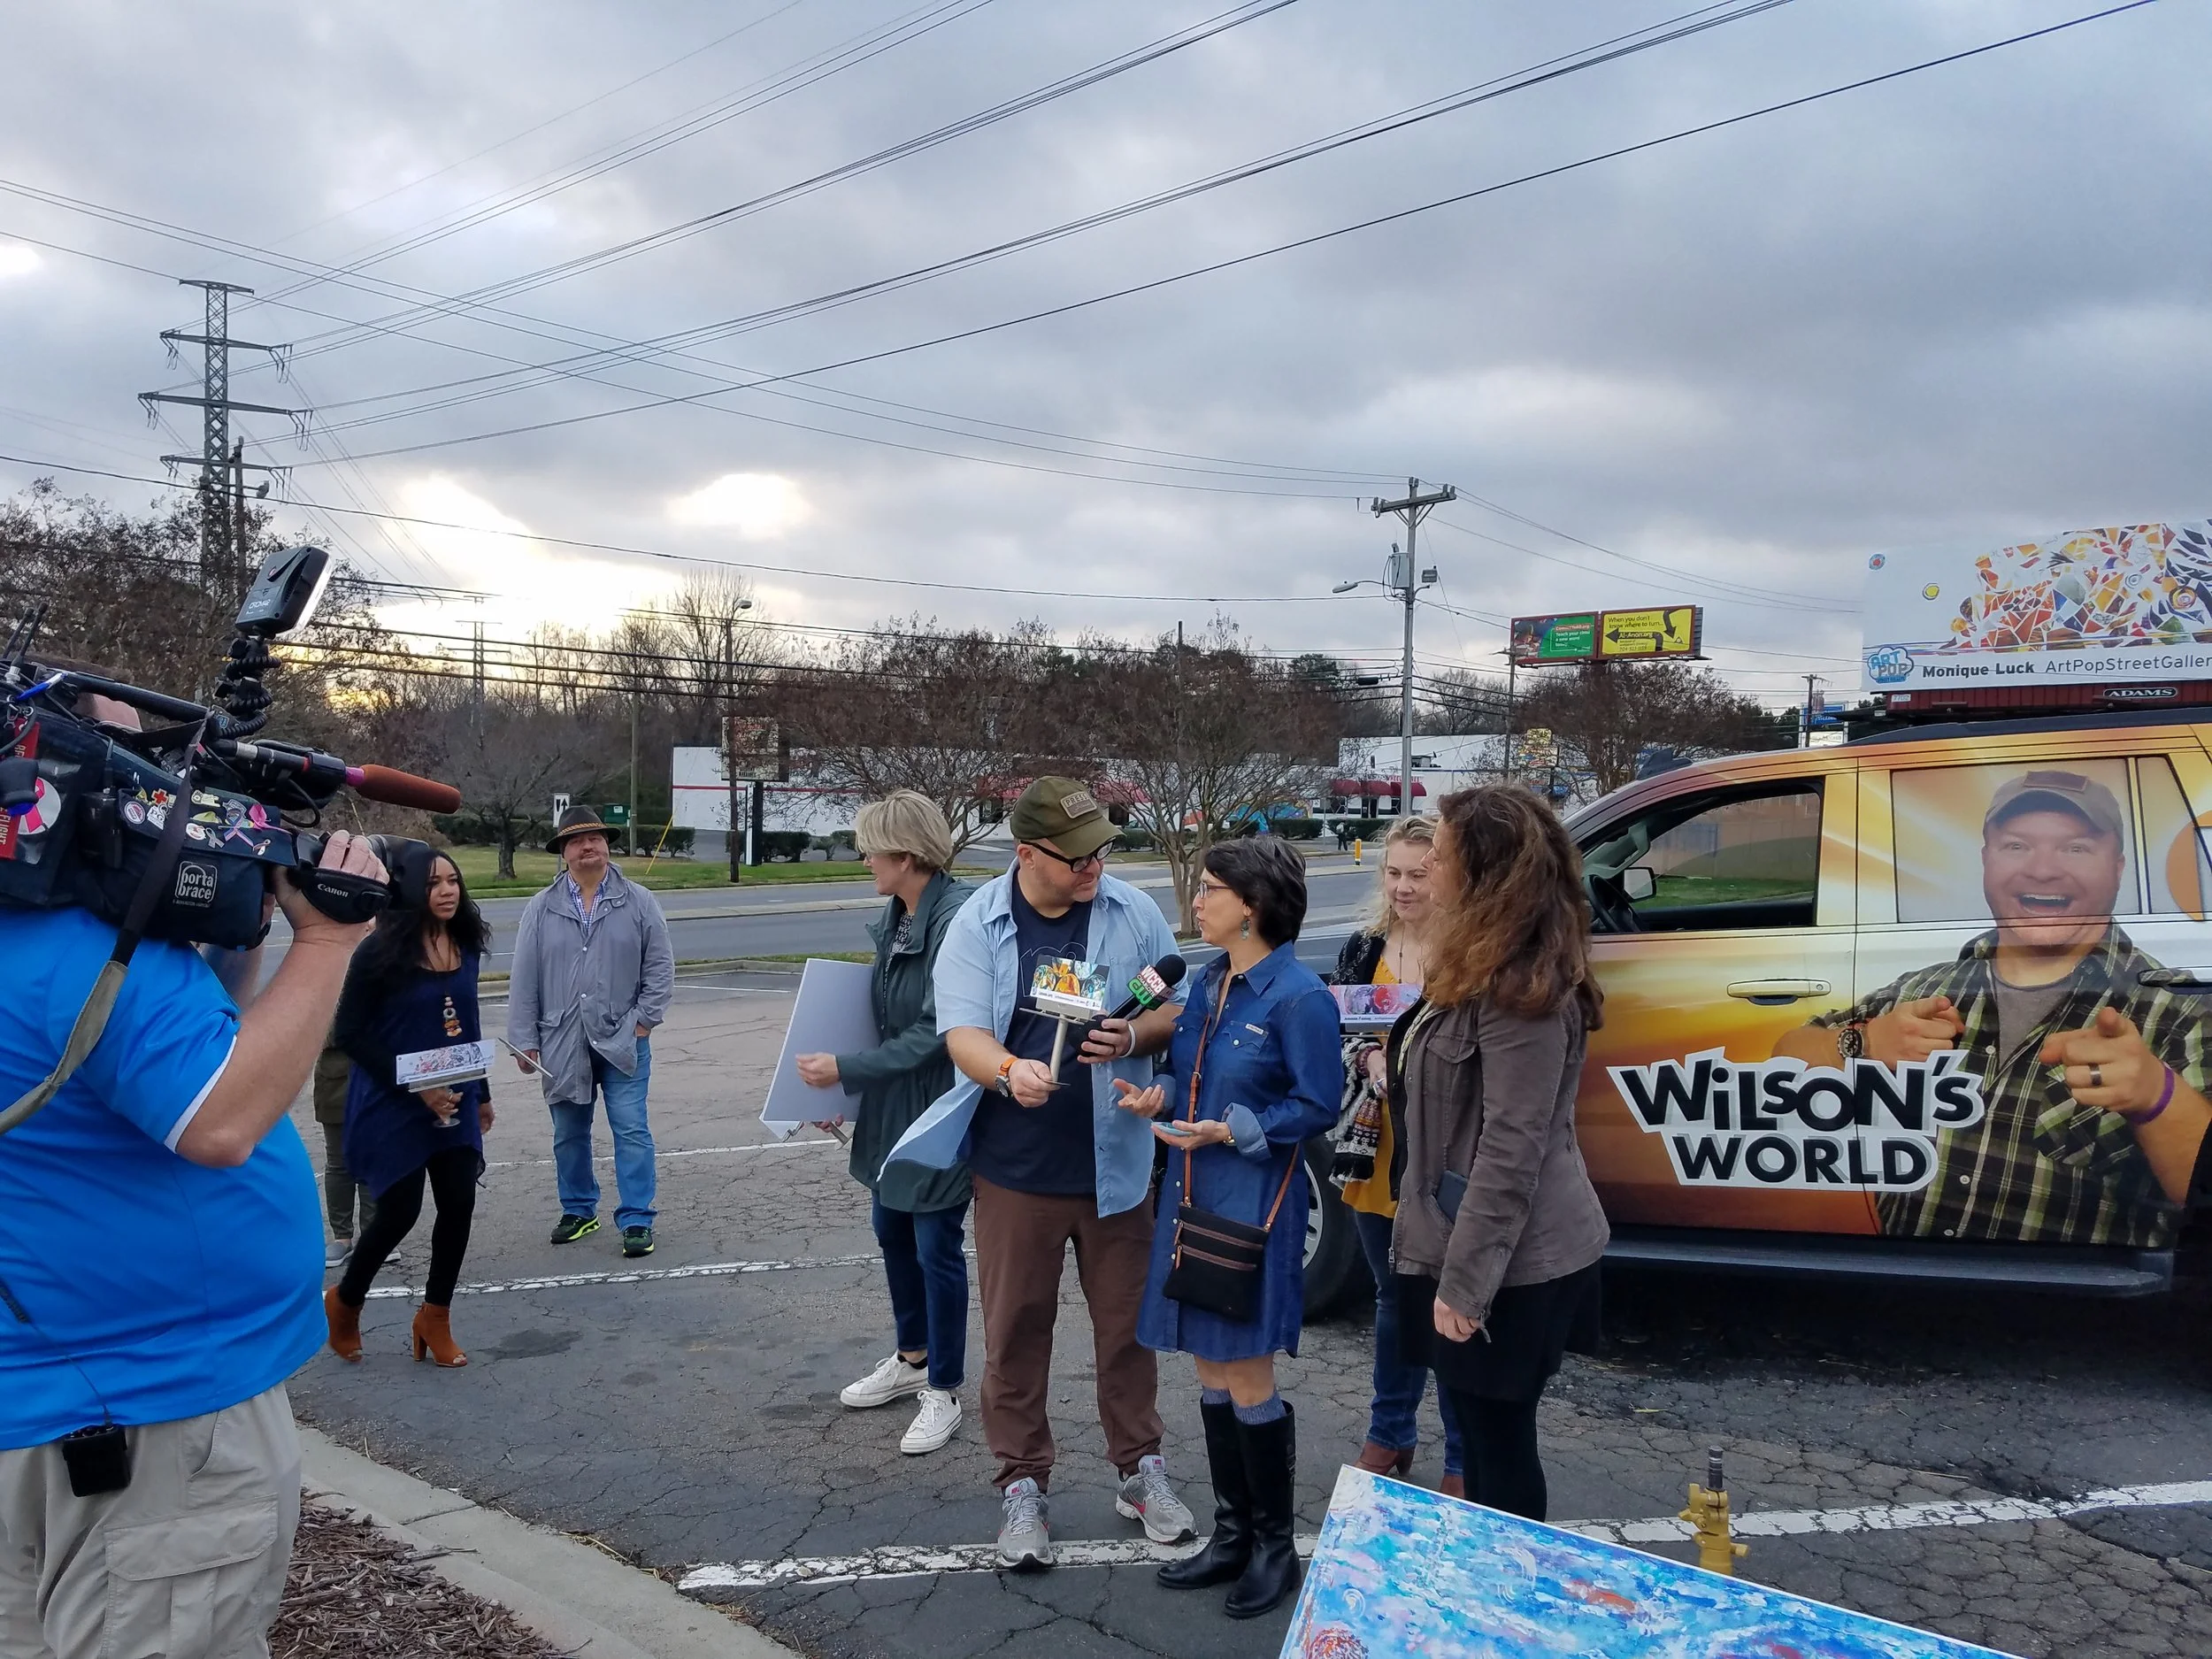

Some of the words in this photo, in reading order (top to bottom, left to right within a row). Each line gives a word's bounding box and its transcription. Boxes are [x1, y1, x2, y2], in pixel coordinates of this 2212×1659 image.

[1870, 650, 1900, 670] ART
[1923, 664, 1989, 679] Monique
[1995, 662, 2034, 674] Luck
[2046, 654, 2212, 673] ArtPopStreetGaller
[1878, 663, 1908, 677] POP
[2108, 688, 2173, 697] ADAMS
[1065, 794, 1087, 805] PRESS
[181, 872, 213, 887] porta
[178, 885, 211, 900] brace
[318, 884, 349, 897] Canon
[1141, 964, 1167, 995] WCCB
[1619, 1056, 1974, 1132] WiLSON'S
[1672, 1136, 1927, 1185] WORLD
